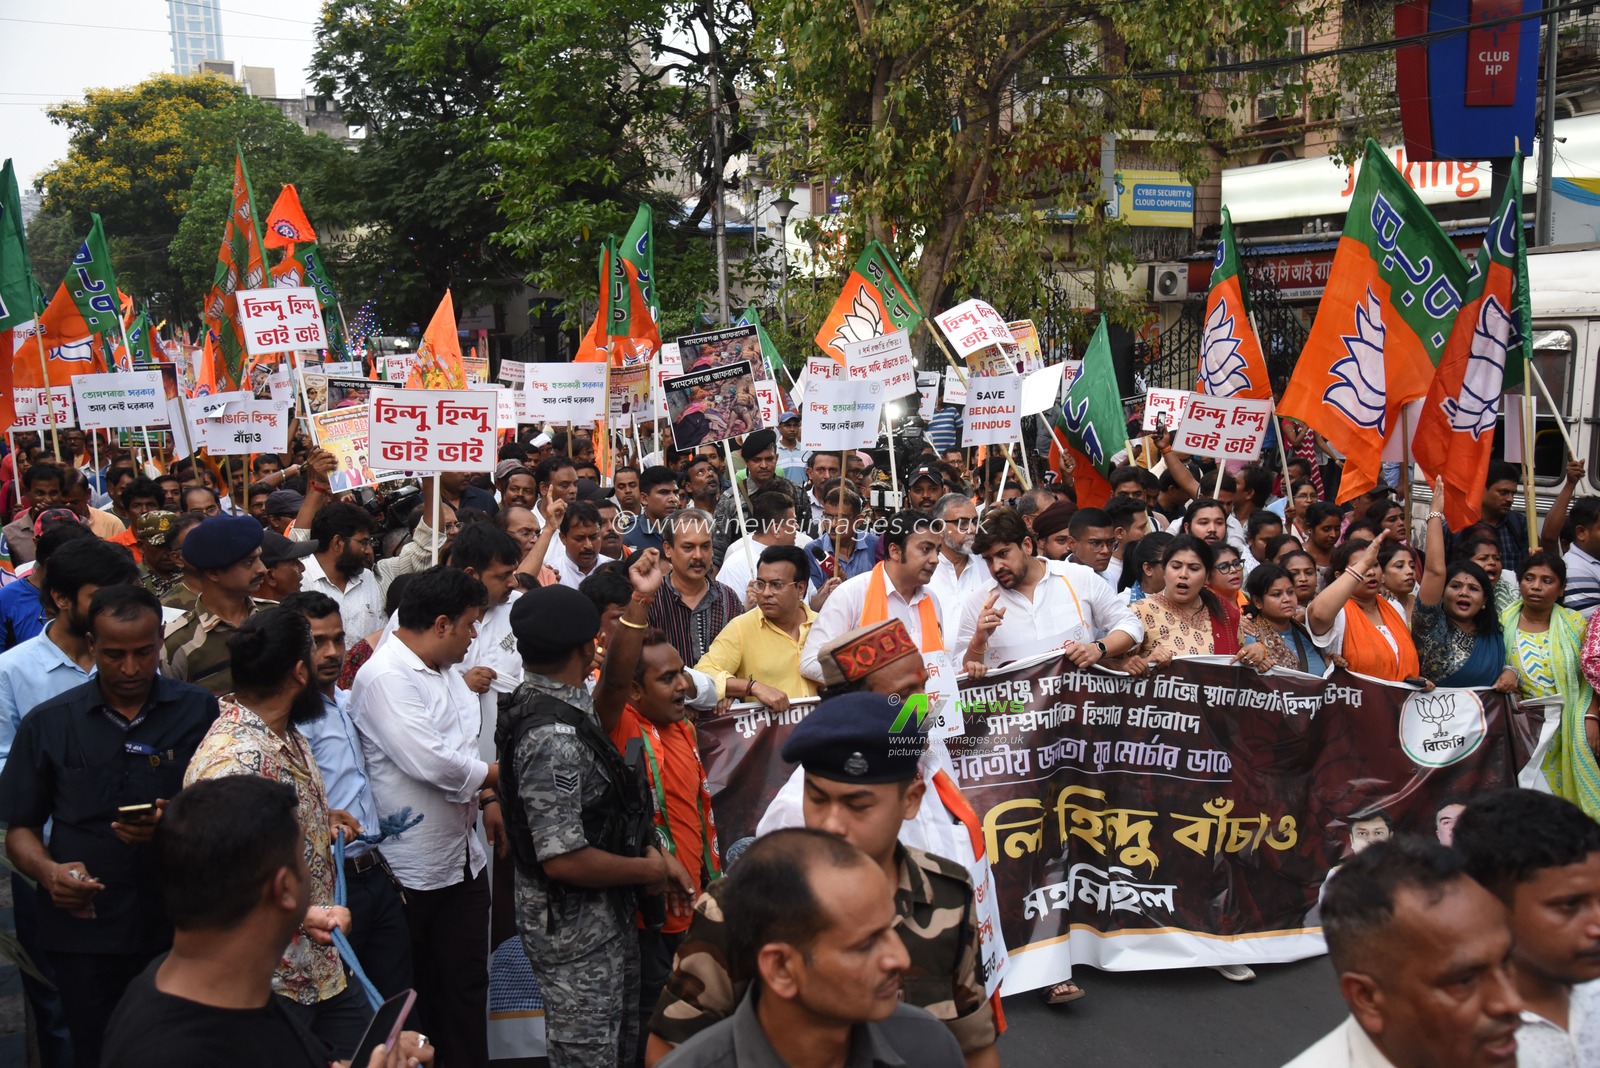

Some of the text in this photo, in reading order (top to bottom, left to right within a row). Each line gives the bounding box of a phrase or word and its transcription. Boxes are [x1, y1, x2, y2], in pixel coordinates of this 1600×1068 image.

[1478, 51, 1510, 62] CLUB
[1485, 64, 1503, 76] HP
[1137, 188, 1192, 198] CYBER SECURITY &
[1134, 198, 1192, 208] CLOUD COMPUTING
[1278, 259, 1290, 282] সি
[1291, 258, 1314, 283] আই
[1315, 260, 1333, 280] ব্যা
[243, 295, 320, 320] হিন্দু হিন্দু
[942, 304, 1002, 333] হিন্দু হিন্দু
[255, 323, 320, 346] ভাই ভাই
[684, 334, 720, 346] সামসেরগঞ্জ
[959, 324, 1008, 348] ভাই ভাই
[386, 358, 404, 370] হিন্দু
[405, 358, 414, 366] হি
[810, 362, 842, 378] হিন্দু হি
[850, 365, 868, 378] হিন্দু
[868, 360, 882, 373] যদি
[390, 370, 405, 380] ভাই
[670, 375, 712, 389] সামসেরগঞ্জ
[712, 366, 744, 380] জাফরাবাদ
[1064, 366, 1078, 380] হি
[128, 388, 156, 397] সরকার
[532, 380, 548, 391] হিন্দু
[582, 381, 604, 389] সরকার
[542, 396, 556, 404] আর
[558, 396, 572, 404] নেই
[757, 388, 774, 404] ন্দু
[976, 390, 1006, 400] SAVE
[1149, 393, 1176, 411] হিন্দু
[1179, 394, 1189, 410] হি
[88, 401, 154, 412] আর নেই দরকার
[810, 402, 828, 415] হিন্দু
[968, 405, 1016, 416] BENGALI
[12, 411, 37, 427] ভাই
[214, 410, 278, 427] বাঙালি হিন্দু
[374, 398, 492, 432] হিন্দু হিন্দু
[1188, 401, 1266, 432] হিন্দু হিন্দু
[328, 422, 350, 437] SAVE
[820, 422, 836, 432] আর
[837, 420, 850, 430] নেই
[970, 420, 1012, 431] HINDUS
[234, 430, 262, 443] বাঁচাও
[1185, 432, 1256, 454] ভাই ভাই
[382, 437, 429, 462] ভাই
[436, 437, 486, 463] ভাই
[1038, 675, 1061, 696] সহ
[1153, 674, 1200, 703] বিভিন্ন
[1204, 685, 1237, 708] স্থানে
[1324, 682, 1363, 708] উপর
[1082, 700, 1124, 728] হিংসার
[1126, 705, 1200, 734] প্রতিবাদে
[1422, 734, 1466, 752] বিজেপি
[1036, 738, 1088, 770] জনতা
[1092, 741, 1112, 772] যুব
[1114, 734, 1182, 770] মোর্চার
[1186, 748, 1232, 774] ডাকে
[981, 785, 1298, 880] লি হিন্দু বাঁচাও
